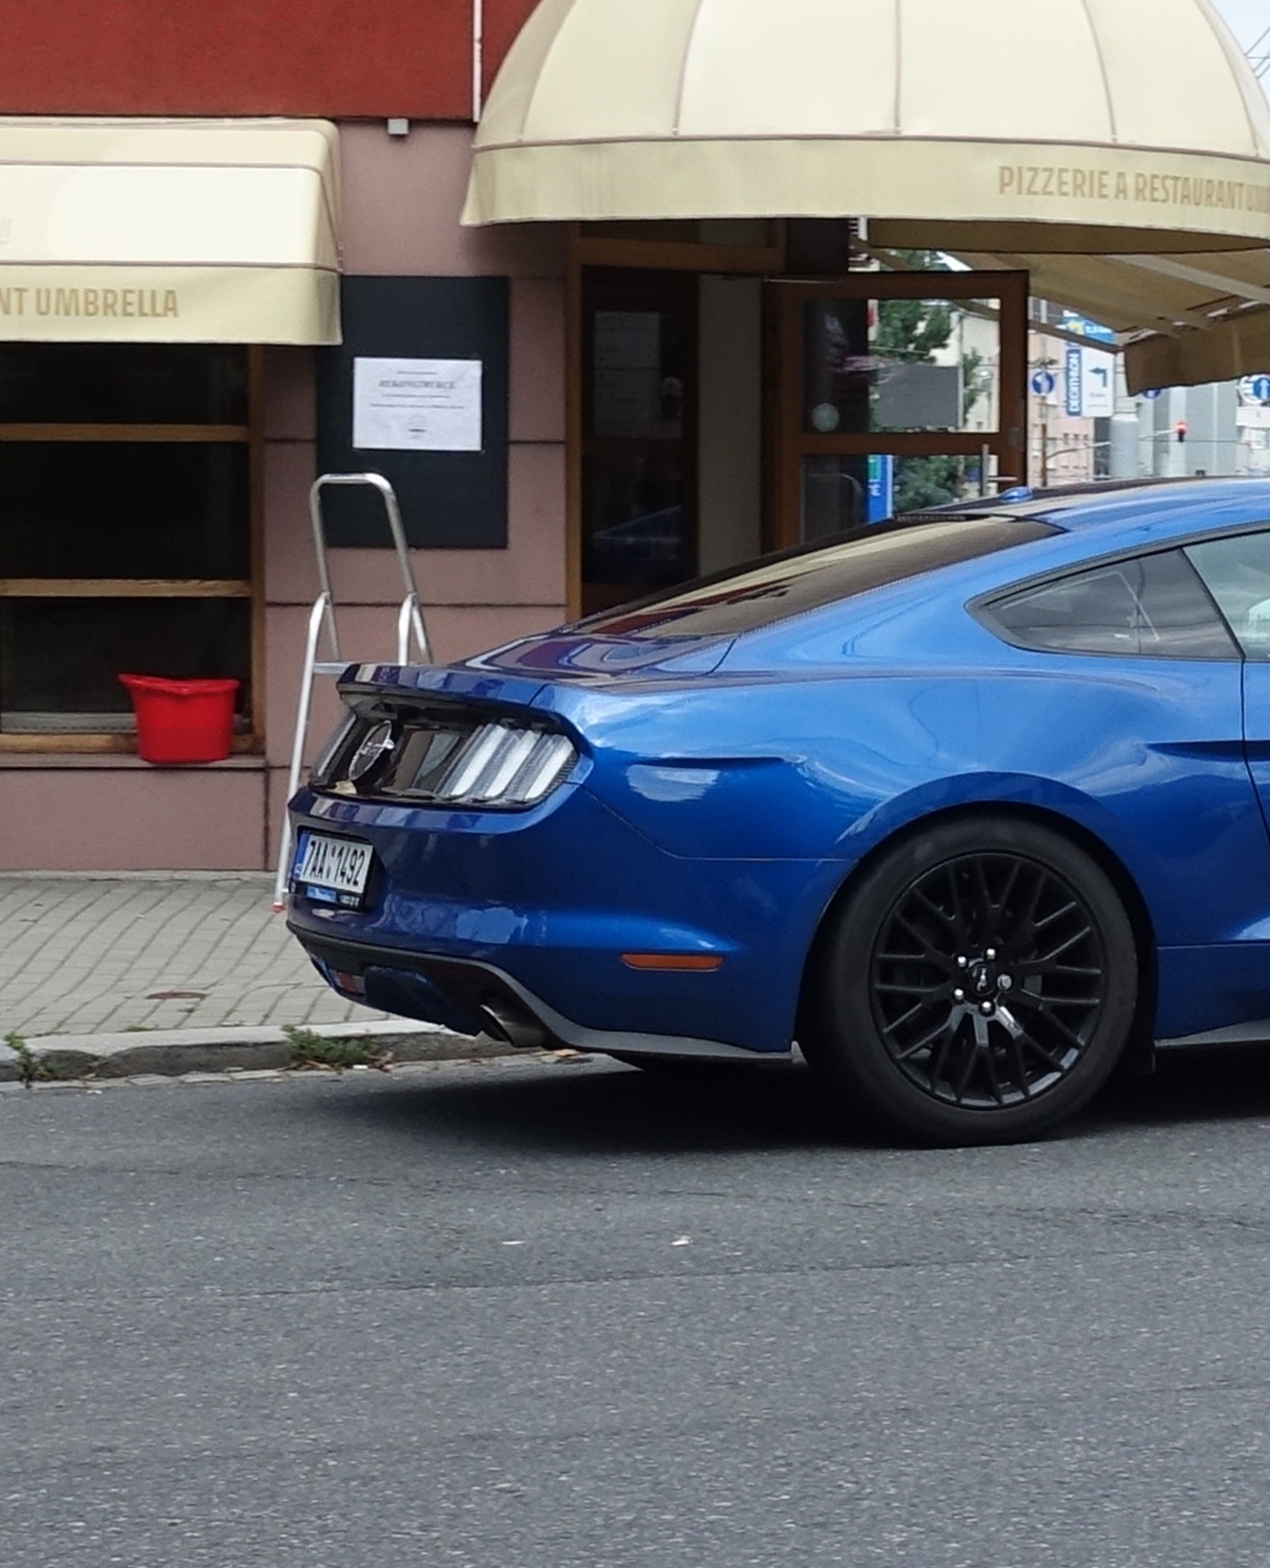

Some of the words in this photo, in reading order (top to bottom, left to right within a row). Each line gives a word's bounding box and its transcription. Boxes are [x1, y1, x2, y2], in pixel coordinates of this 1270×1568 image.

[999, 165, 1109, 200] PIZZERIE
[1114, 171, 1128, 200] A
[1135, 172, 1245, 210] RESTAURANT
[35, 287, 180, 318] UMBRELLA
[334, 846, 366, 887] 1492
